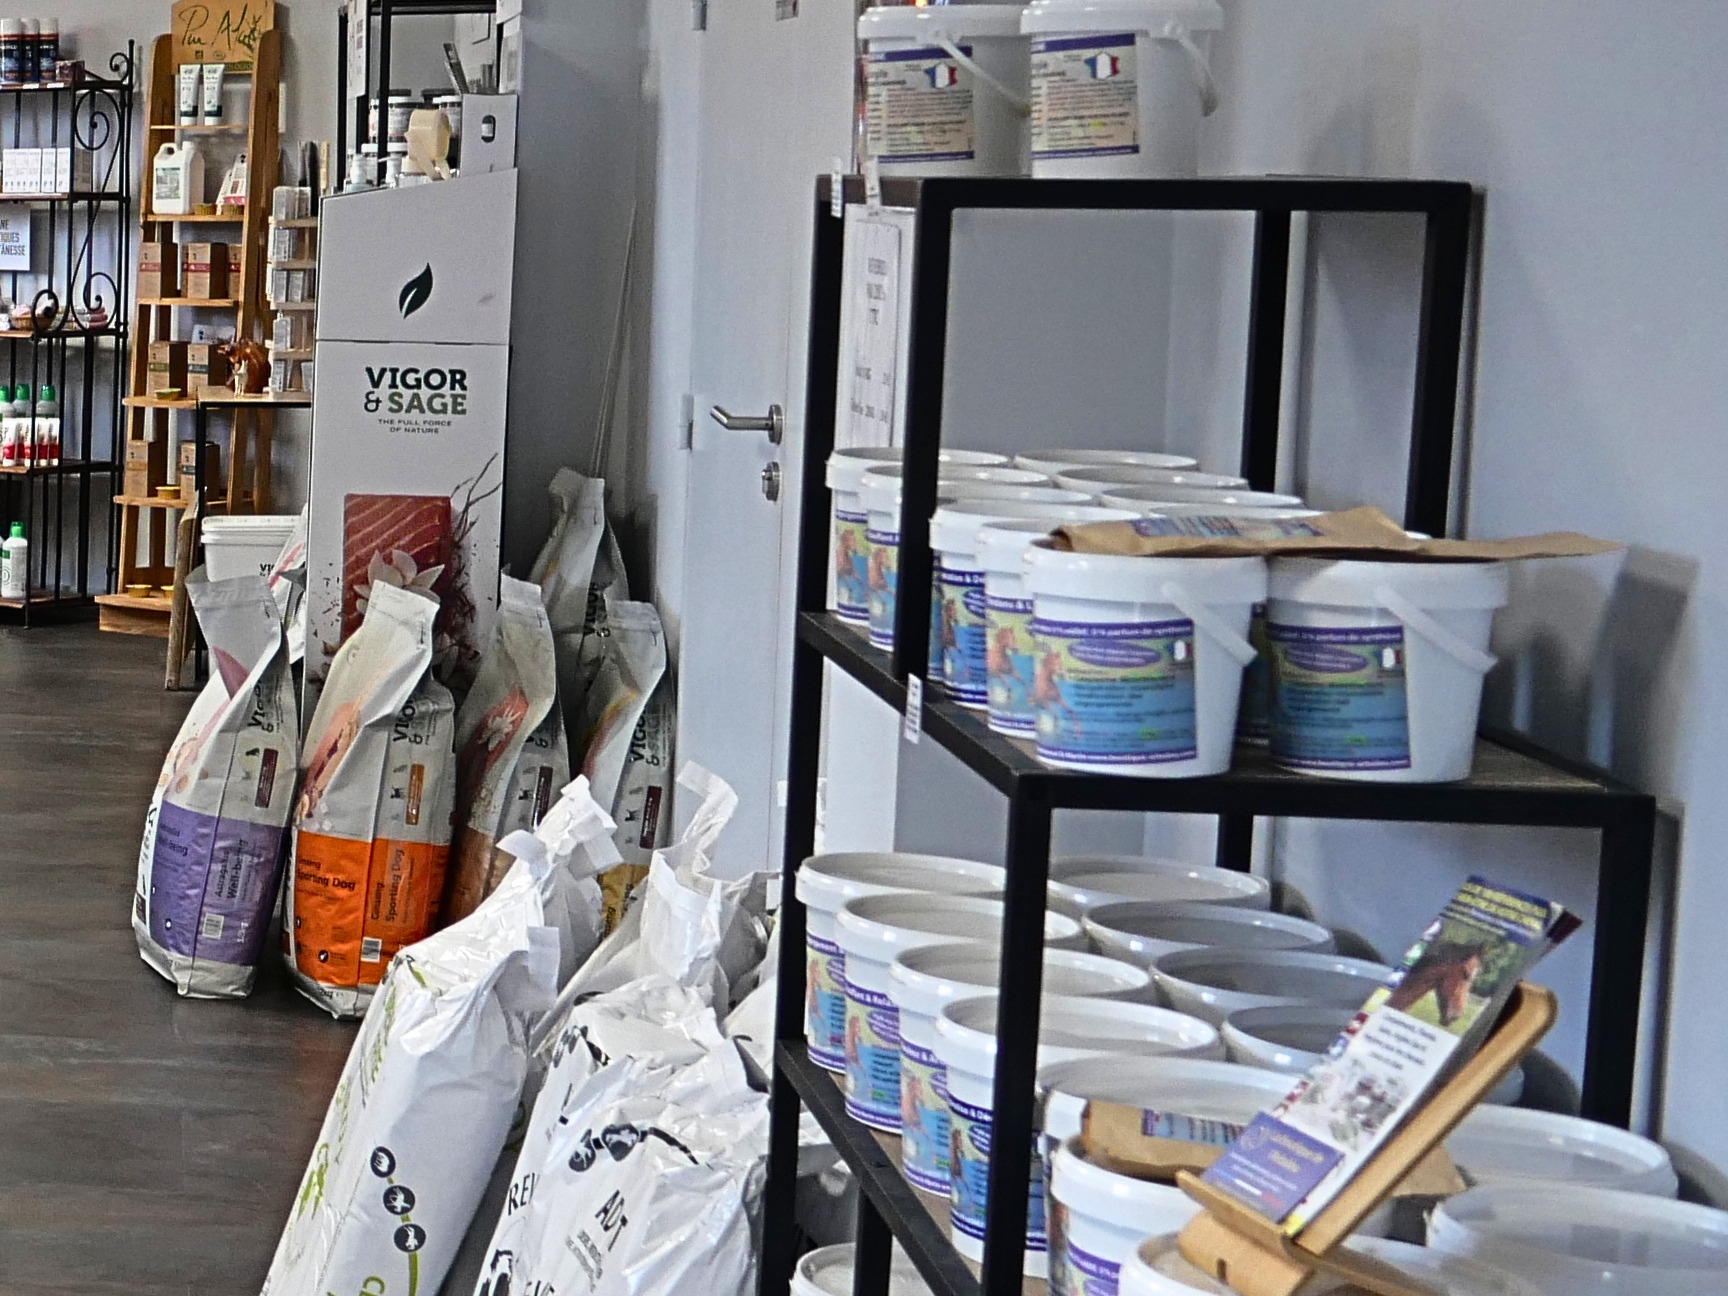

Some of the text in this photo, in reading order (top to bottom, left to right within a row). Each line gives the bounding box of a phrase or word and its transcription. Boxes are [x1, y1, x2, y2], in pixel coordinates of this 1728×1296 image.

[365, 366, 468, 391] VIGOR
[364, 391, 467, 415] & SAGE
[378, 418, 394, 426] THE
[423, 419, 452, 427] FORCE
